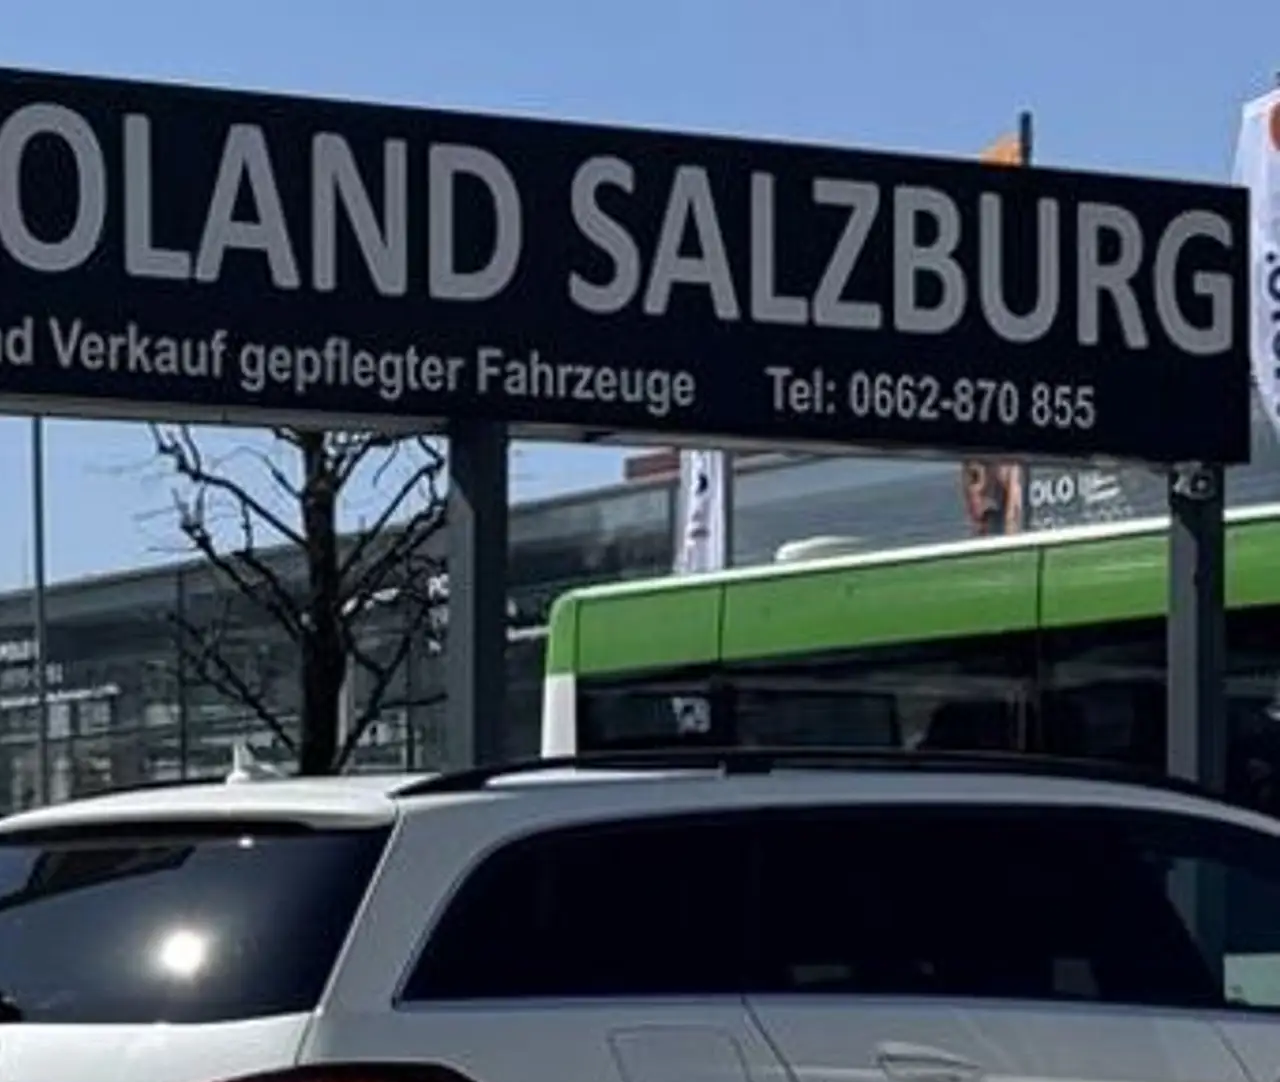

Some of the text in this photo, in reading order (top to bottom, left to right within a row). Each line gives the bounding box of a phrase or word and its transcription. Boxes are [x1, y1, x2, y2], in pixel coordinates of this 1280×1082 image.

[568, 154, 1234, 356] SALZBURG
[47, 315, 228, 379] Verkauf
[239, 329, 464, 404] gepflegter
[476, 346, 696, 417] Fahrzeuge
[765, 367, 837, 414] Tel:
[850, 378, 1019, 424] 0662-870
[1032, 384, 1096, 429] 855
